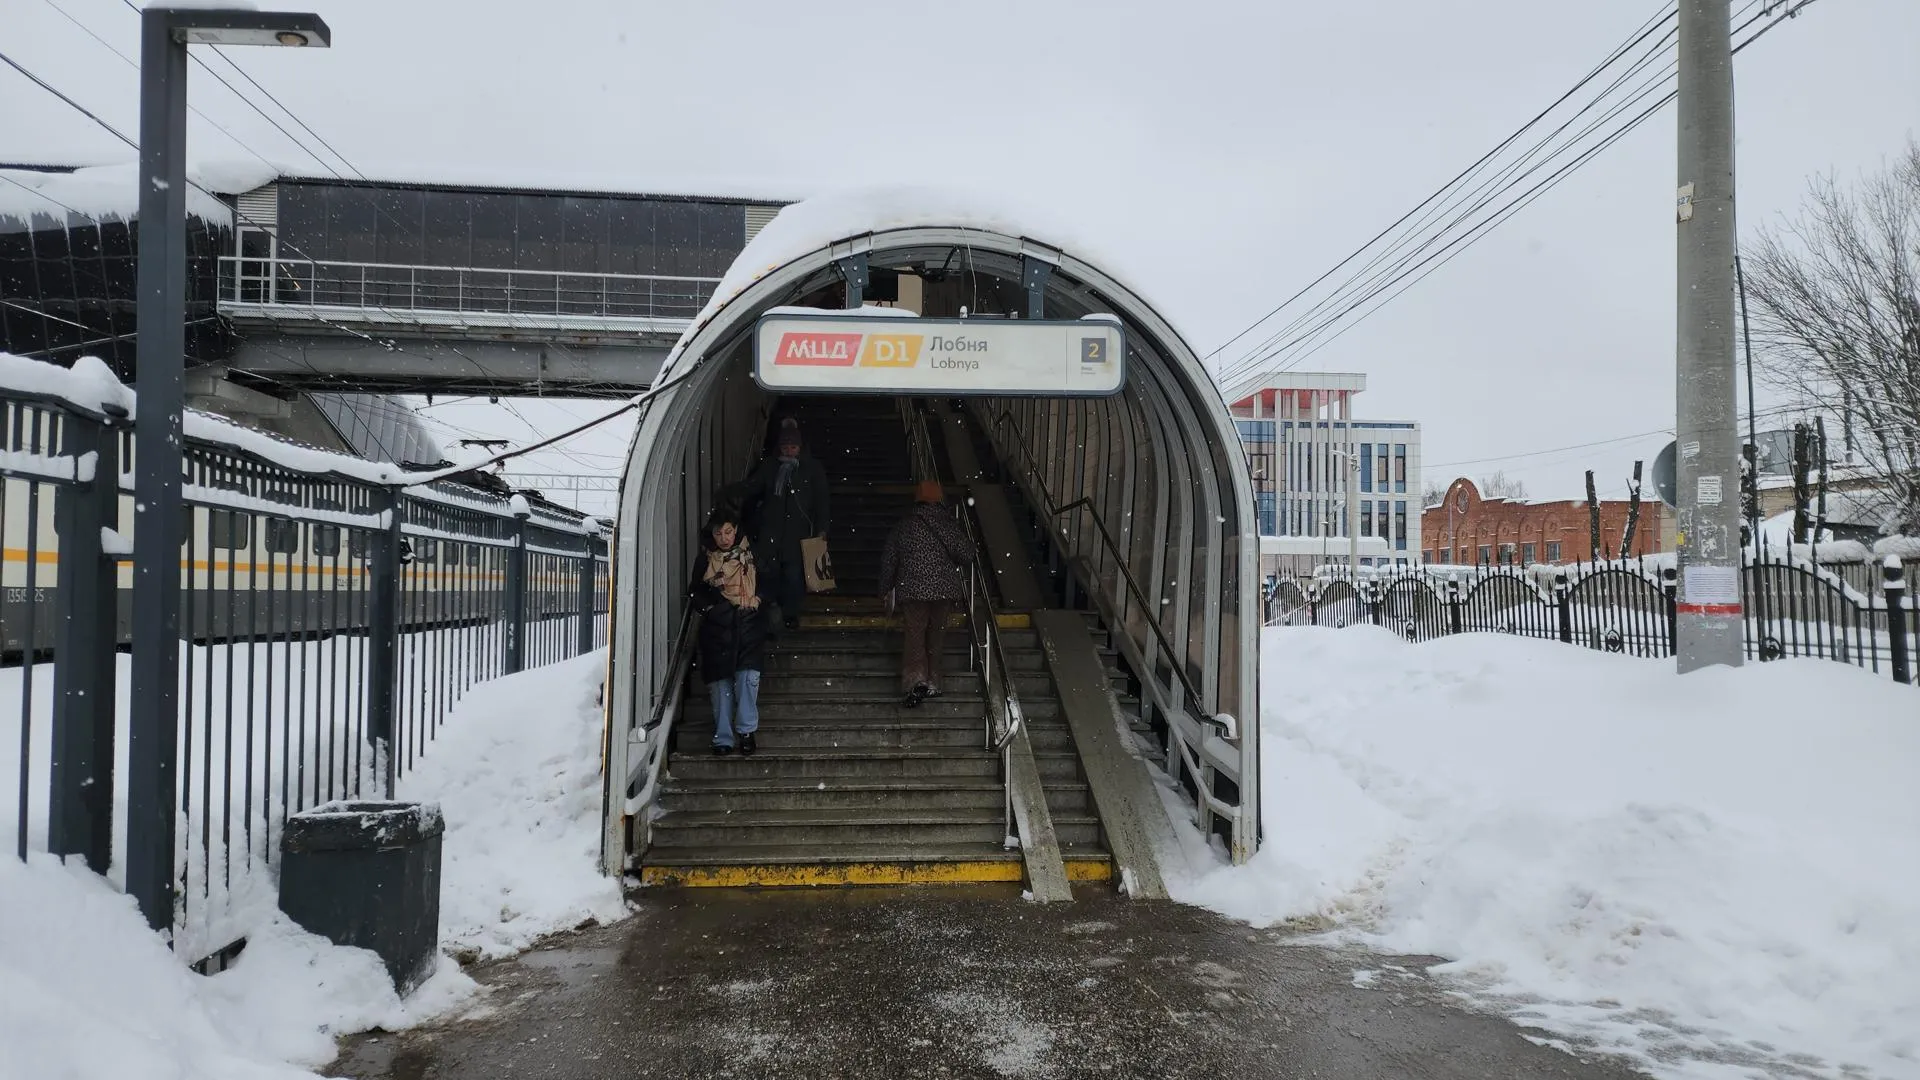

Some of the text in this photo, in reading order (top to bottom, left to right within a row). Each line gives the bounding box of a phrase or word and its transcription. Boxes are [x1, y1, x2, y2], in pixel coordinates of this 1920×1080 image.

[786, 339, 910, 361] МЦД D1
[930, 335, 988, 352] Лобня
[1088, 342, 1100, 358] 2
[931, 357, 979, 369] Lobnya
